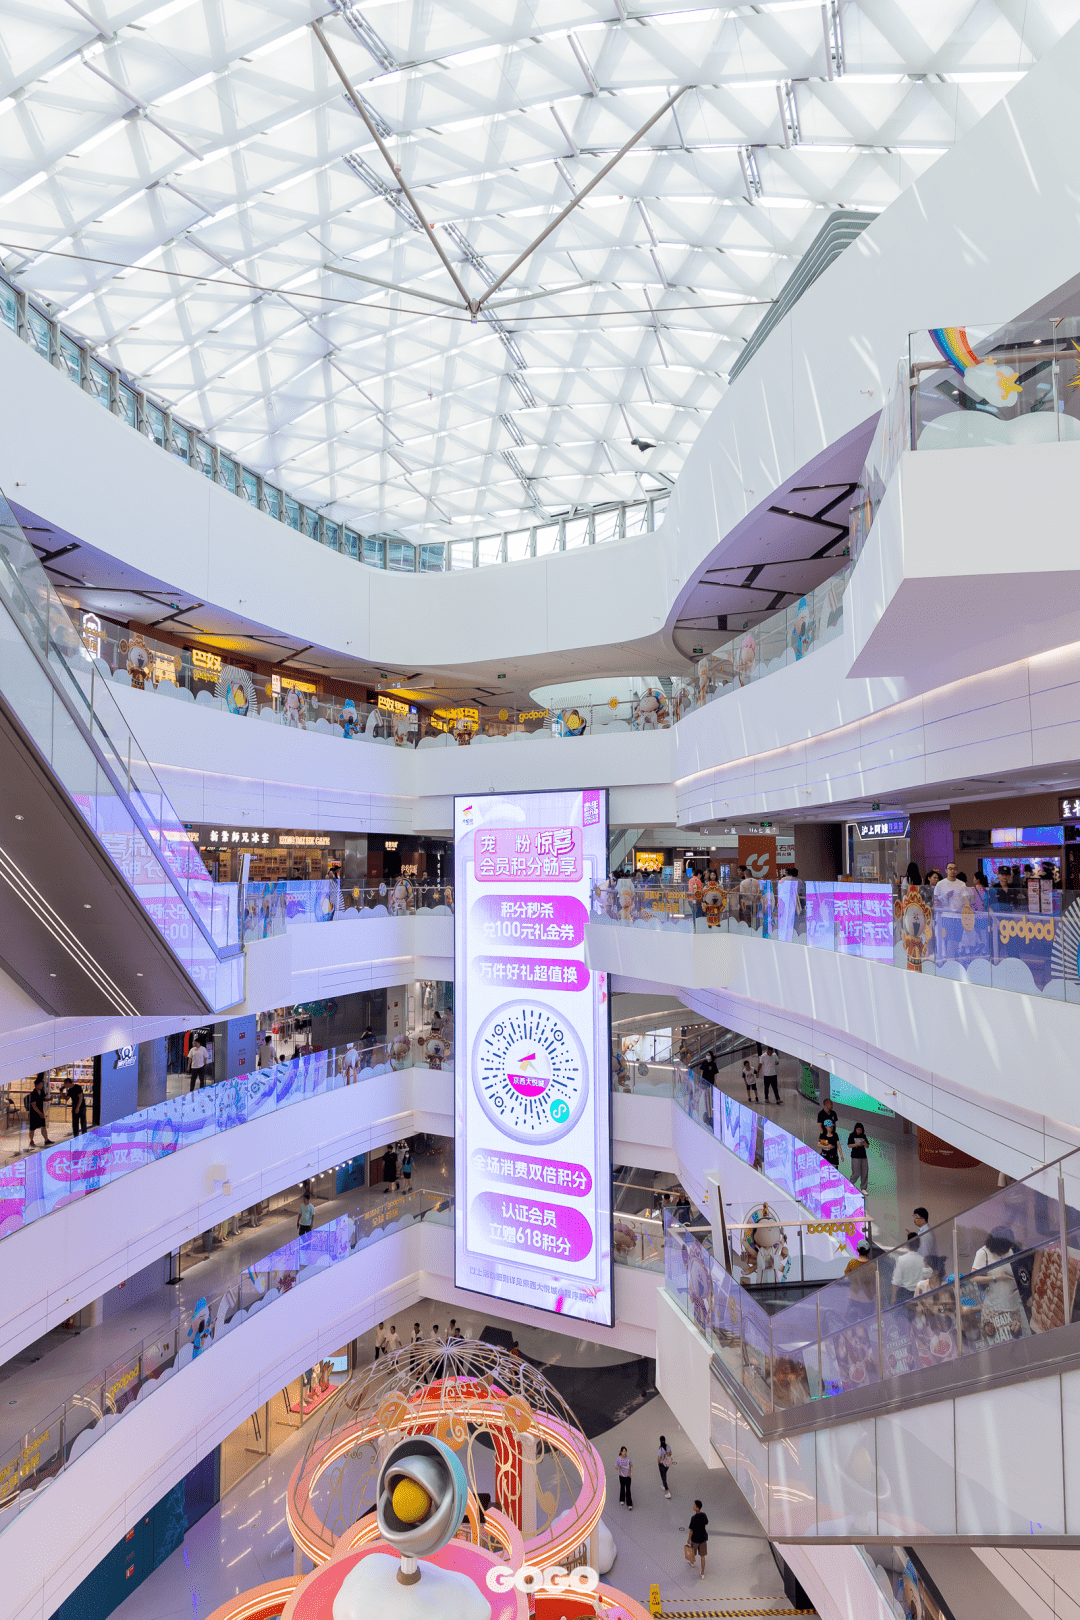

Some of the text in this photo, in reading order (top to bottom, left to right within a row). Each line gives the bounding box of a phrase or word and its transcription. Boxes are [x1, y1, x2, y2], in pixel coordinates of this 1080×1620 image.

[861, 823, 889, 836] 沪上阿姨
[479, 857, 577, 877] 会员积分畅享
[501, 902, 554, 919] 积分秒杀
[483, 920, 575, 941] 兑100元礼金券
[479, 962, 578, 984] 万件好礼超值换
[512, 1077, 545, 1088] 京西大悦城
[472, 1154, 587, 1190] 全场消费双倍积分
[502, 1201, 557, 1229] 认证会员
[489, 1222, 571, 1256] 立赠618积分
